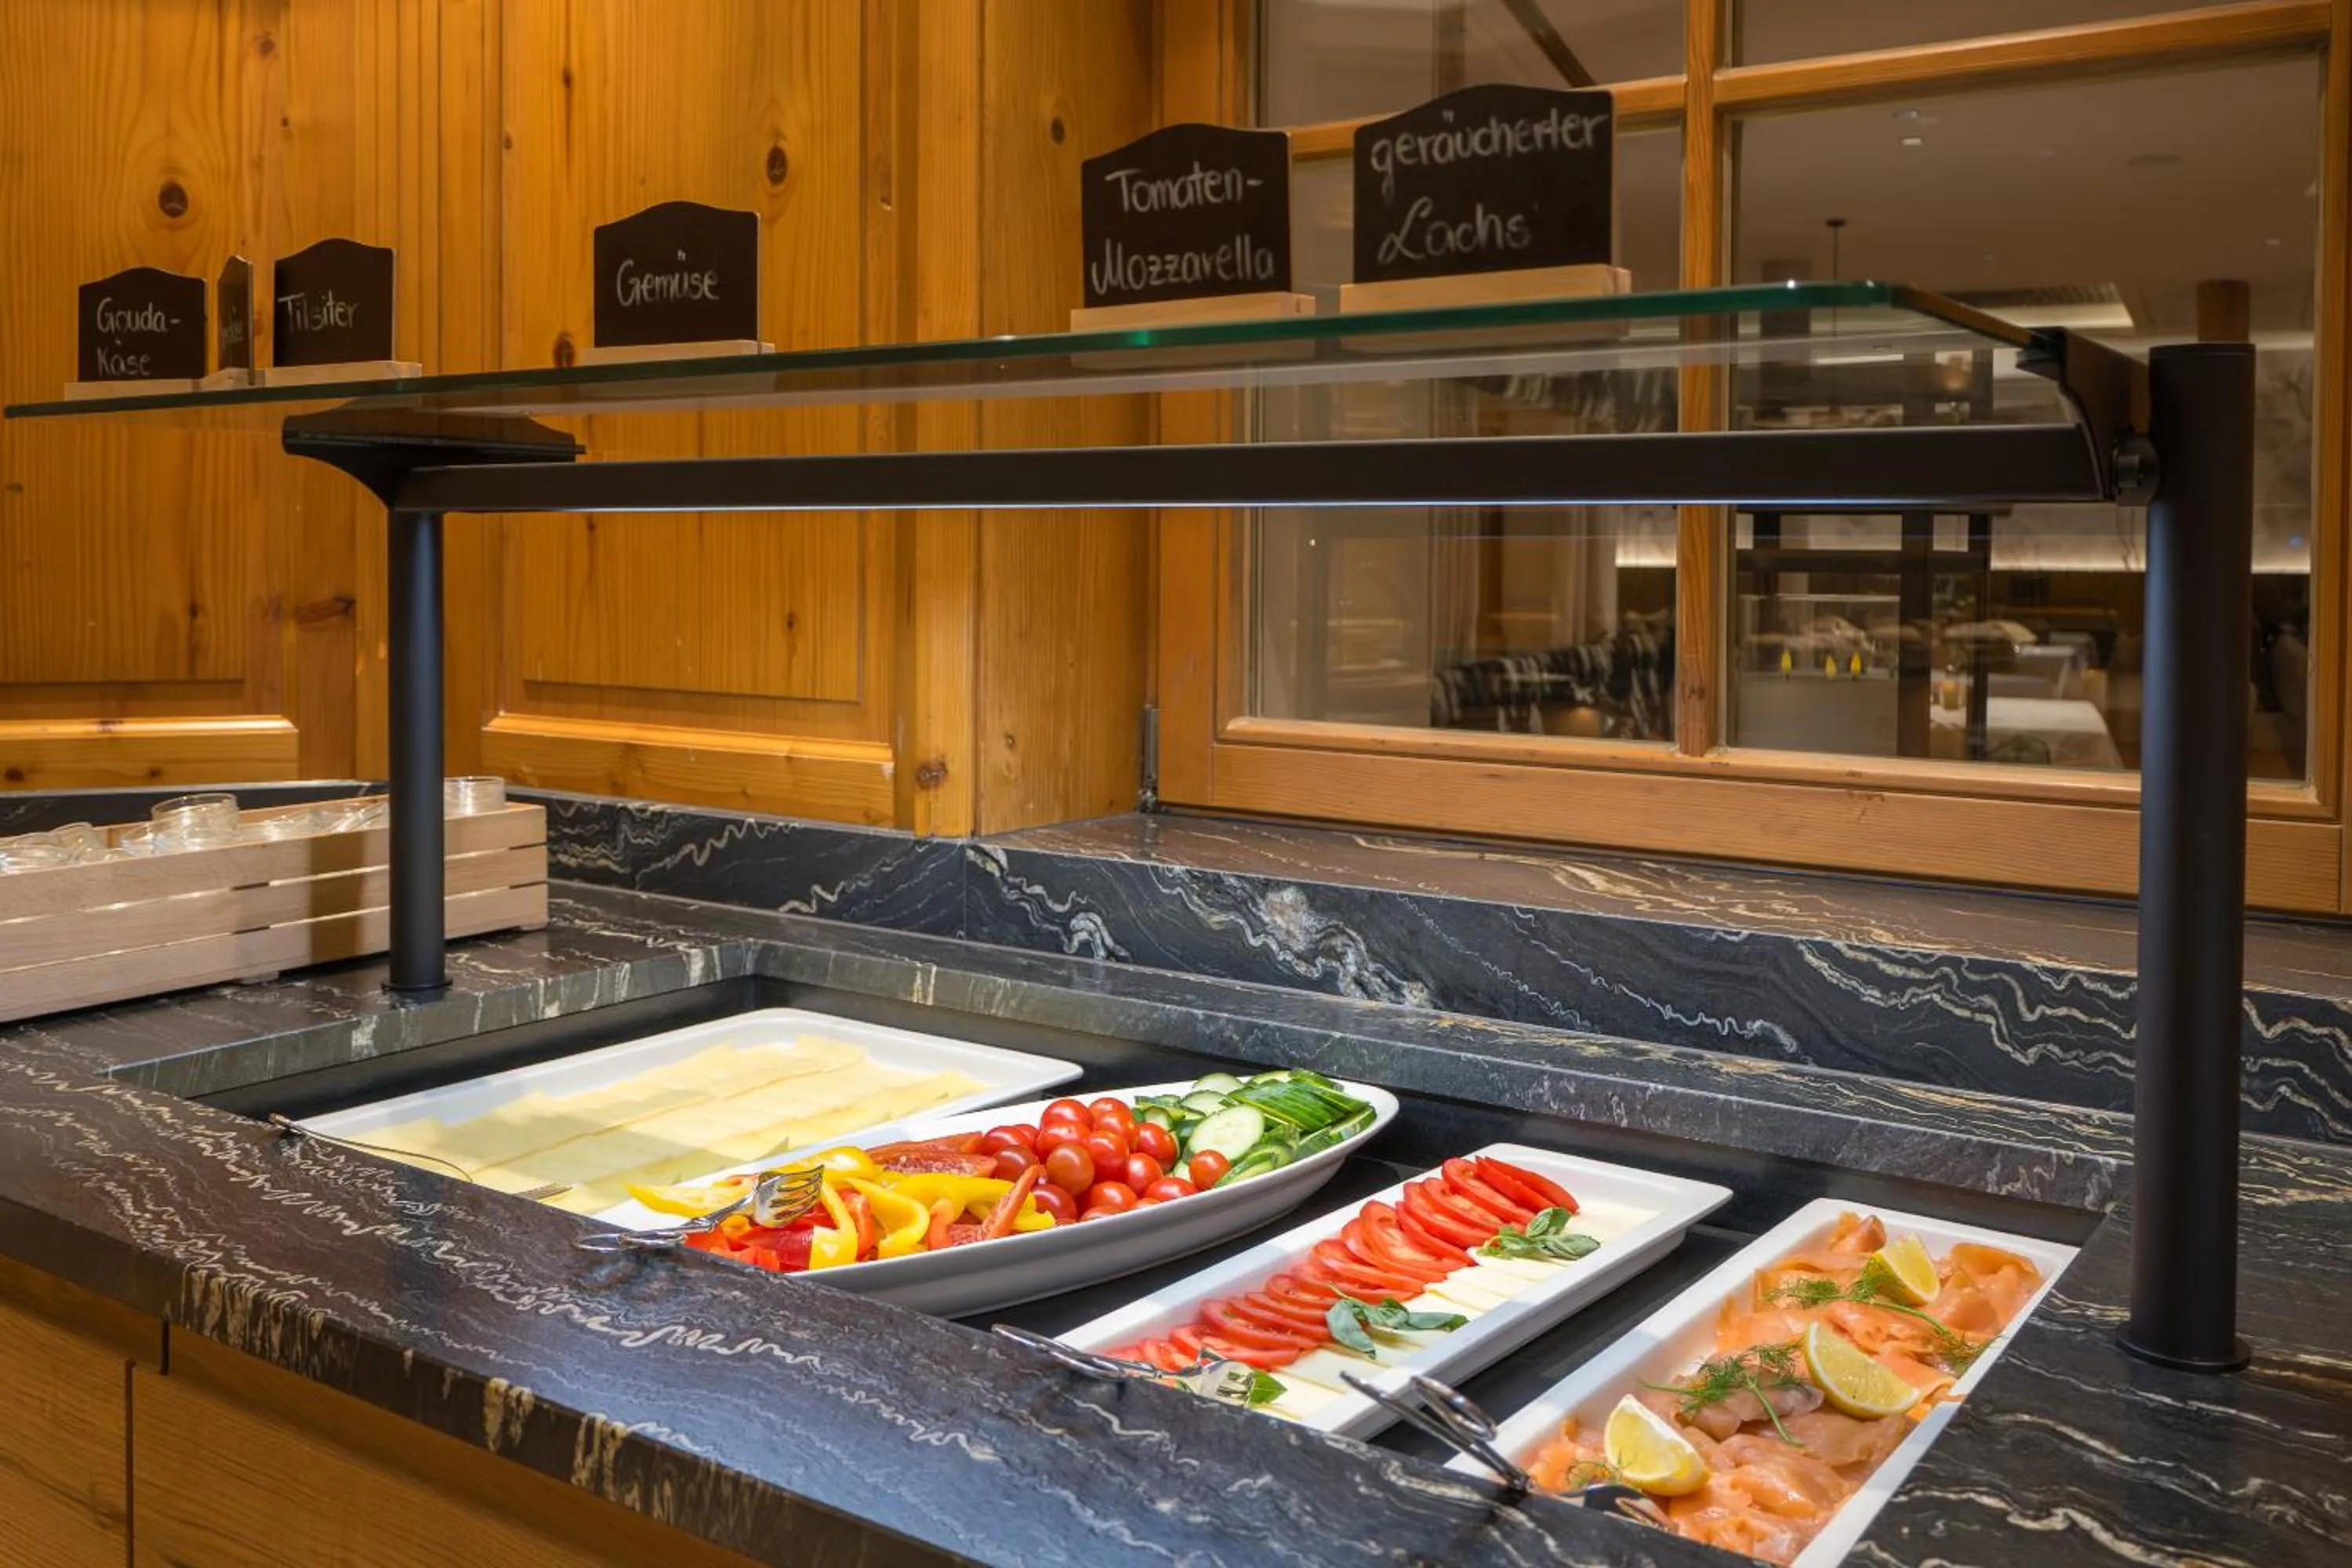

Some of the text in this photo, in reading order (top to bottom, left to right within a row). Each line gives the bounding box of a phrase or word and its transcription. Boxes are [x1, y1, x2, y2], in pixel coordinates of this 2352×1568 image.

[1371, 107, 1610, 204] geräucherter
[1104, 161, 1263, 212] Tomaten-
[1377, 196, 1530, 264] Lachs
[616, 249, 720, 307] Gemüse
[1091, 233, 1274, 295] Mozzarella
[96, 296, 181, 333] Gouda-
